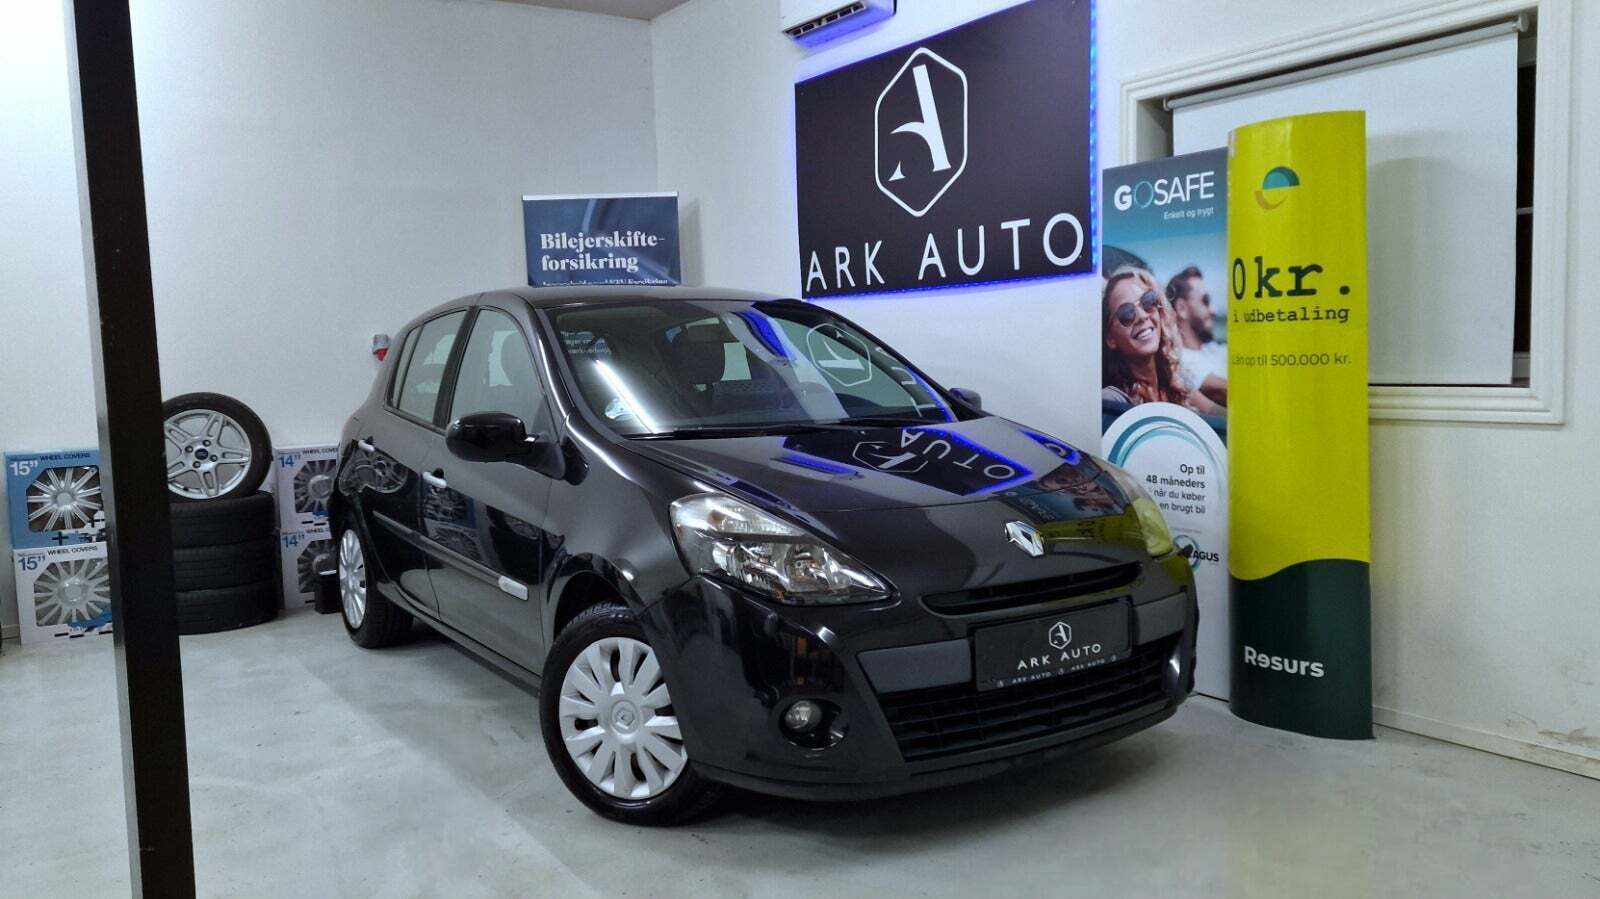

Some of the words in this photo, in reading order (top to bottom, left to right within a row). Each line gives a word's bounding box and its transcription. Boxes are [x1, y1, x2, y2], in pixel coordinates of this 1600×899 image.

[1114, 171, 1215, 211] GOSAFE
[1163, 211, 1185, 220] Enkelt
[1186, 210, 1196, 218] og
[1197, 207, 1214, 217] trygt
[540, 230, 665, 253] Bilejerskifte-
[806, 240, 886, 292] ARK
[918, 212, 1085, 281] AUTO
[541, 253, 640, 272] forsikring
[1232, 257, 1247, 301] 0
[1254, 256, 1351, 299] kr.
[1233, 310, 1240, 323] i
[1244, 305, 1350, 324] udbetaling
[1257, 354, 1268, 366] til
[1271, 353, 1331, 367] 500.000
[1334, 352, 1353, 365] kr.
[1180, 463, 1194, 475] Op
[1196, 465, 1206, 475] til
[1146, 475, 1158, 484] 48
[1160, 476, 1206, 489] måneders
[1153, 488, 1167, 497] når
[1168, 490, 1180, 499] du
[1181, 491, 1206, 500] køber
[1171, 502, 1194, 514] brugt
[1195, 505, 1206, 514] bil
[71, 545, 98, 553] COVERS
[1192, 550, 1220, 562] AGUS
[1017, 654, 1051, 671] ARK
[1060, 643, 1102, 662] AUTO
[1030, 671, 1052, 680] AUTO
